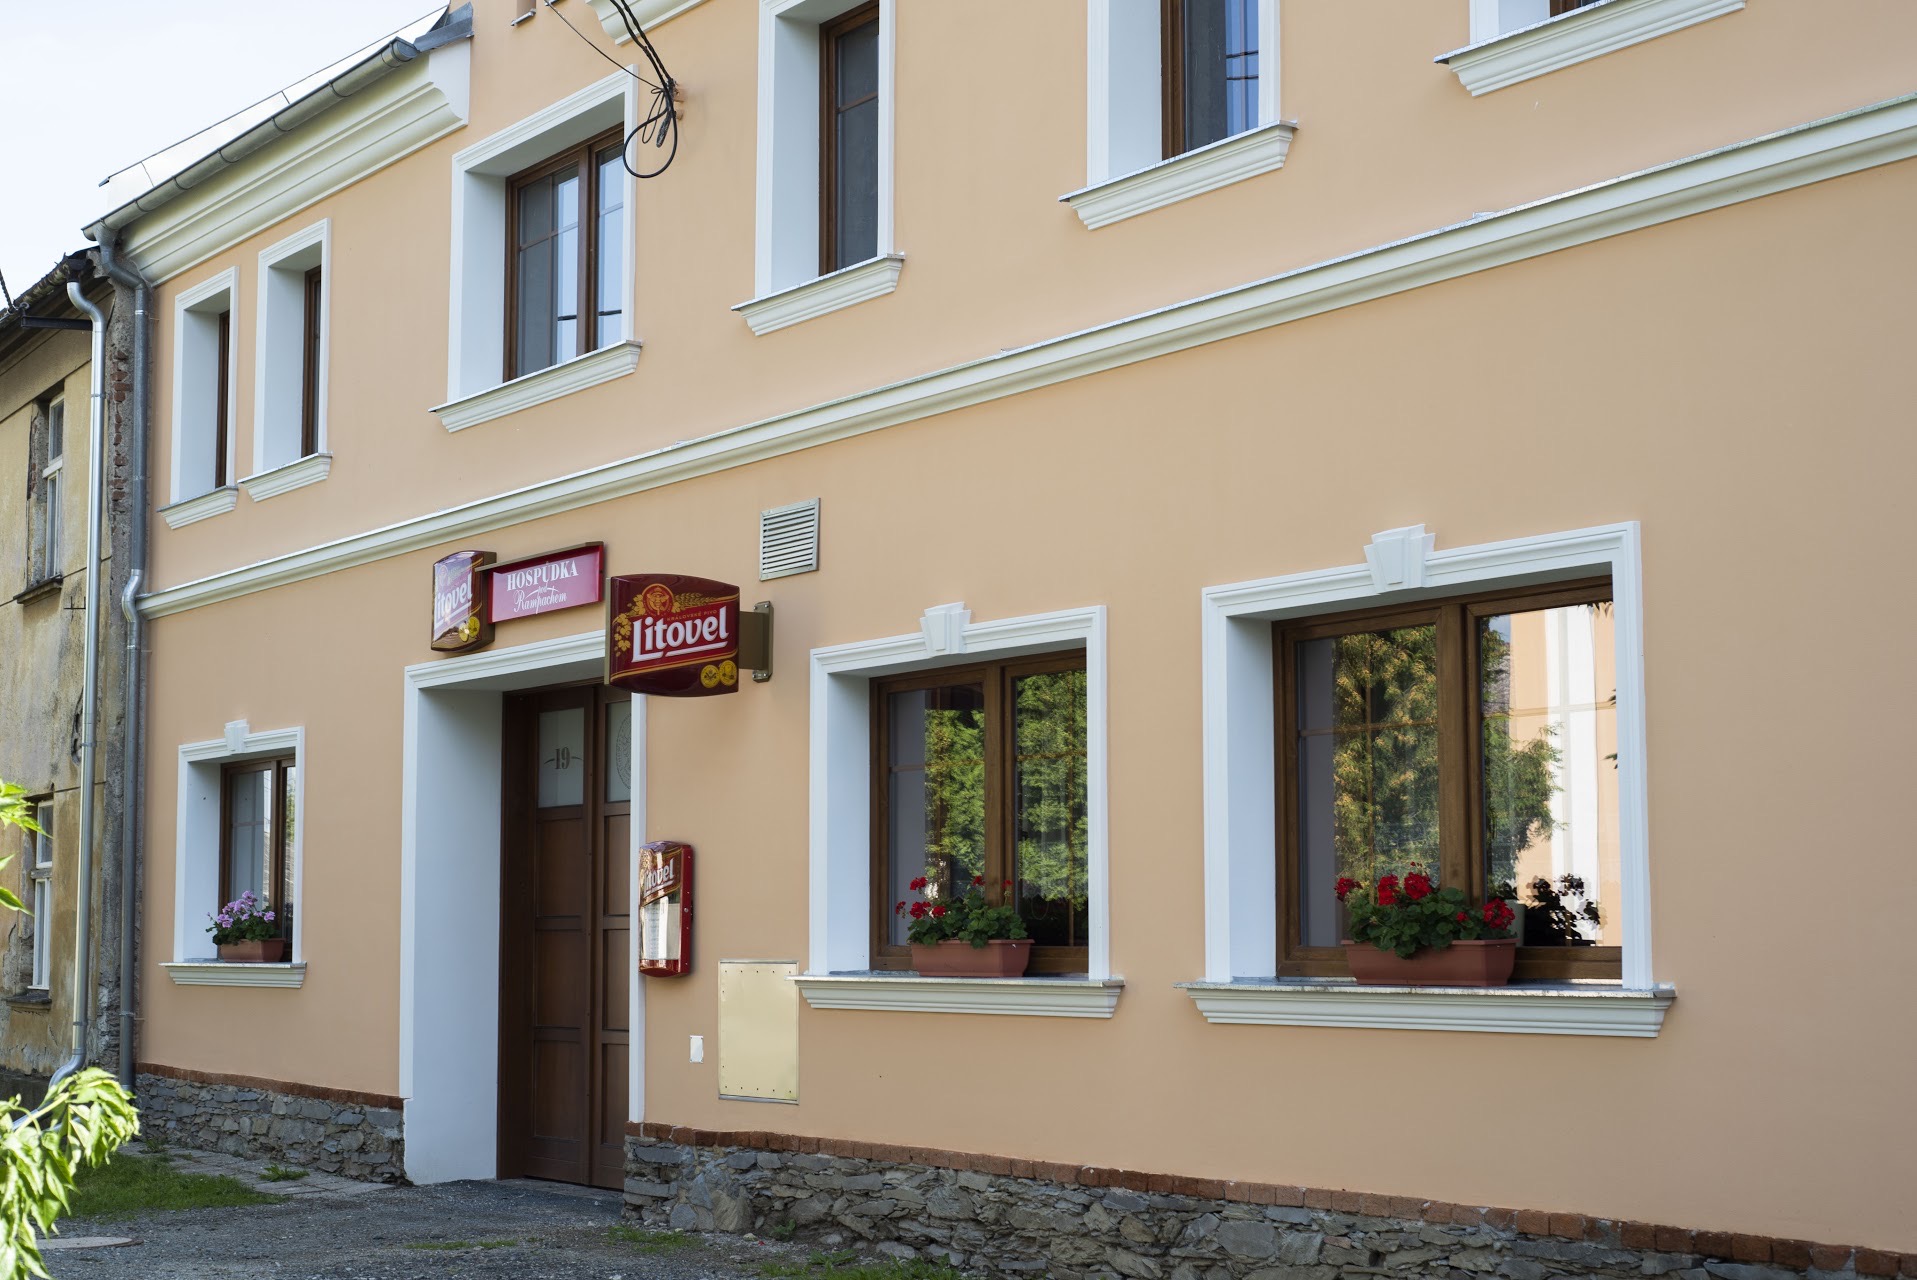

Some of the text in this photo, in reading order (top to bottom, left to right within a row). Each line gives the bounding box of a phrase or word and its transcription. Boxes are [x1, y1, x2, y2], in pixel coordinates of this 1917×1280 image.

[513, 586, 567, 614] Rampachem
[631, 605, 729, 663] Litovel
[554, 746, 571, 770] 19
